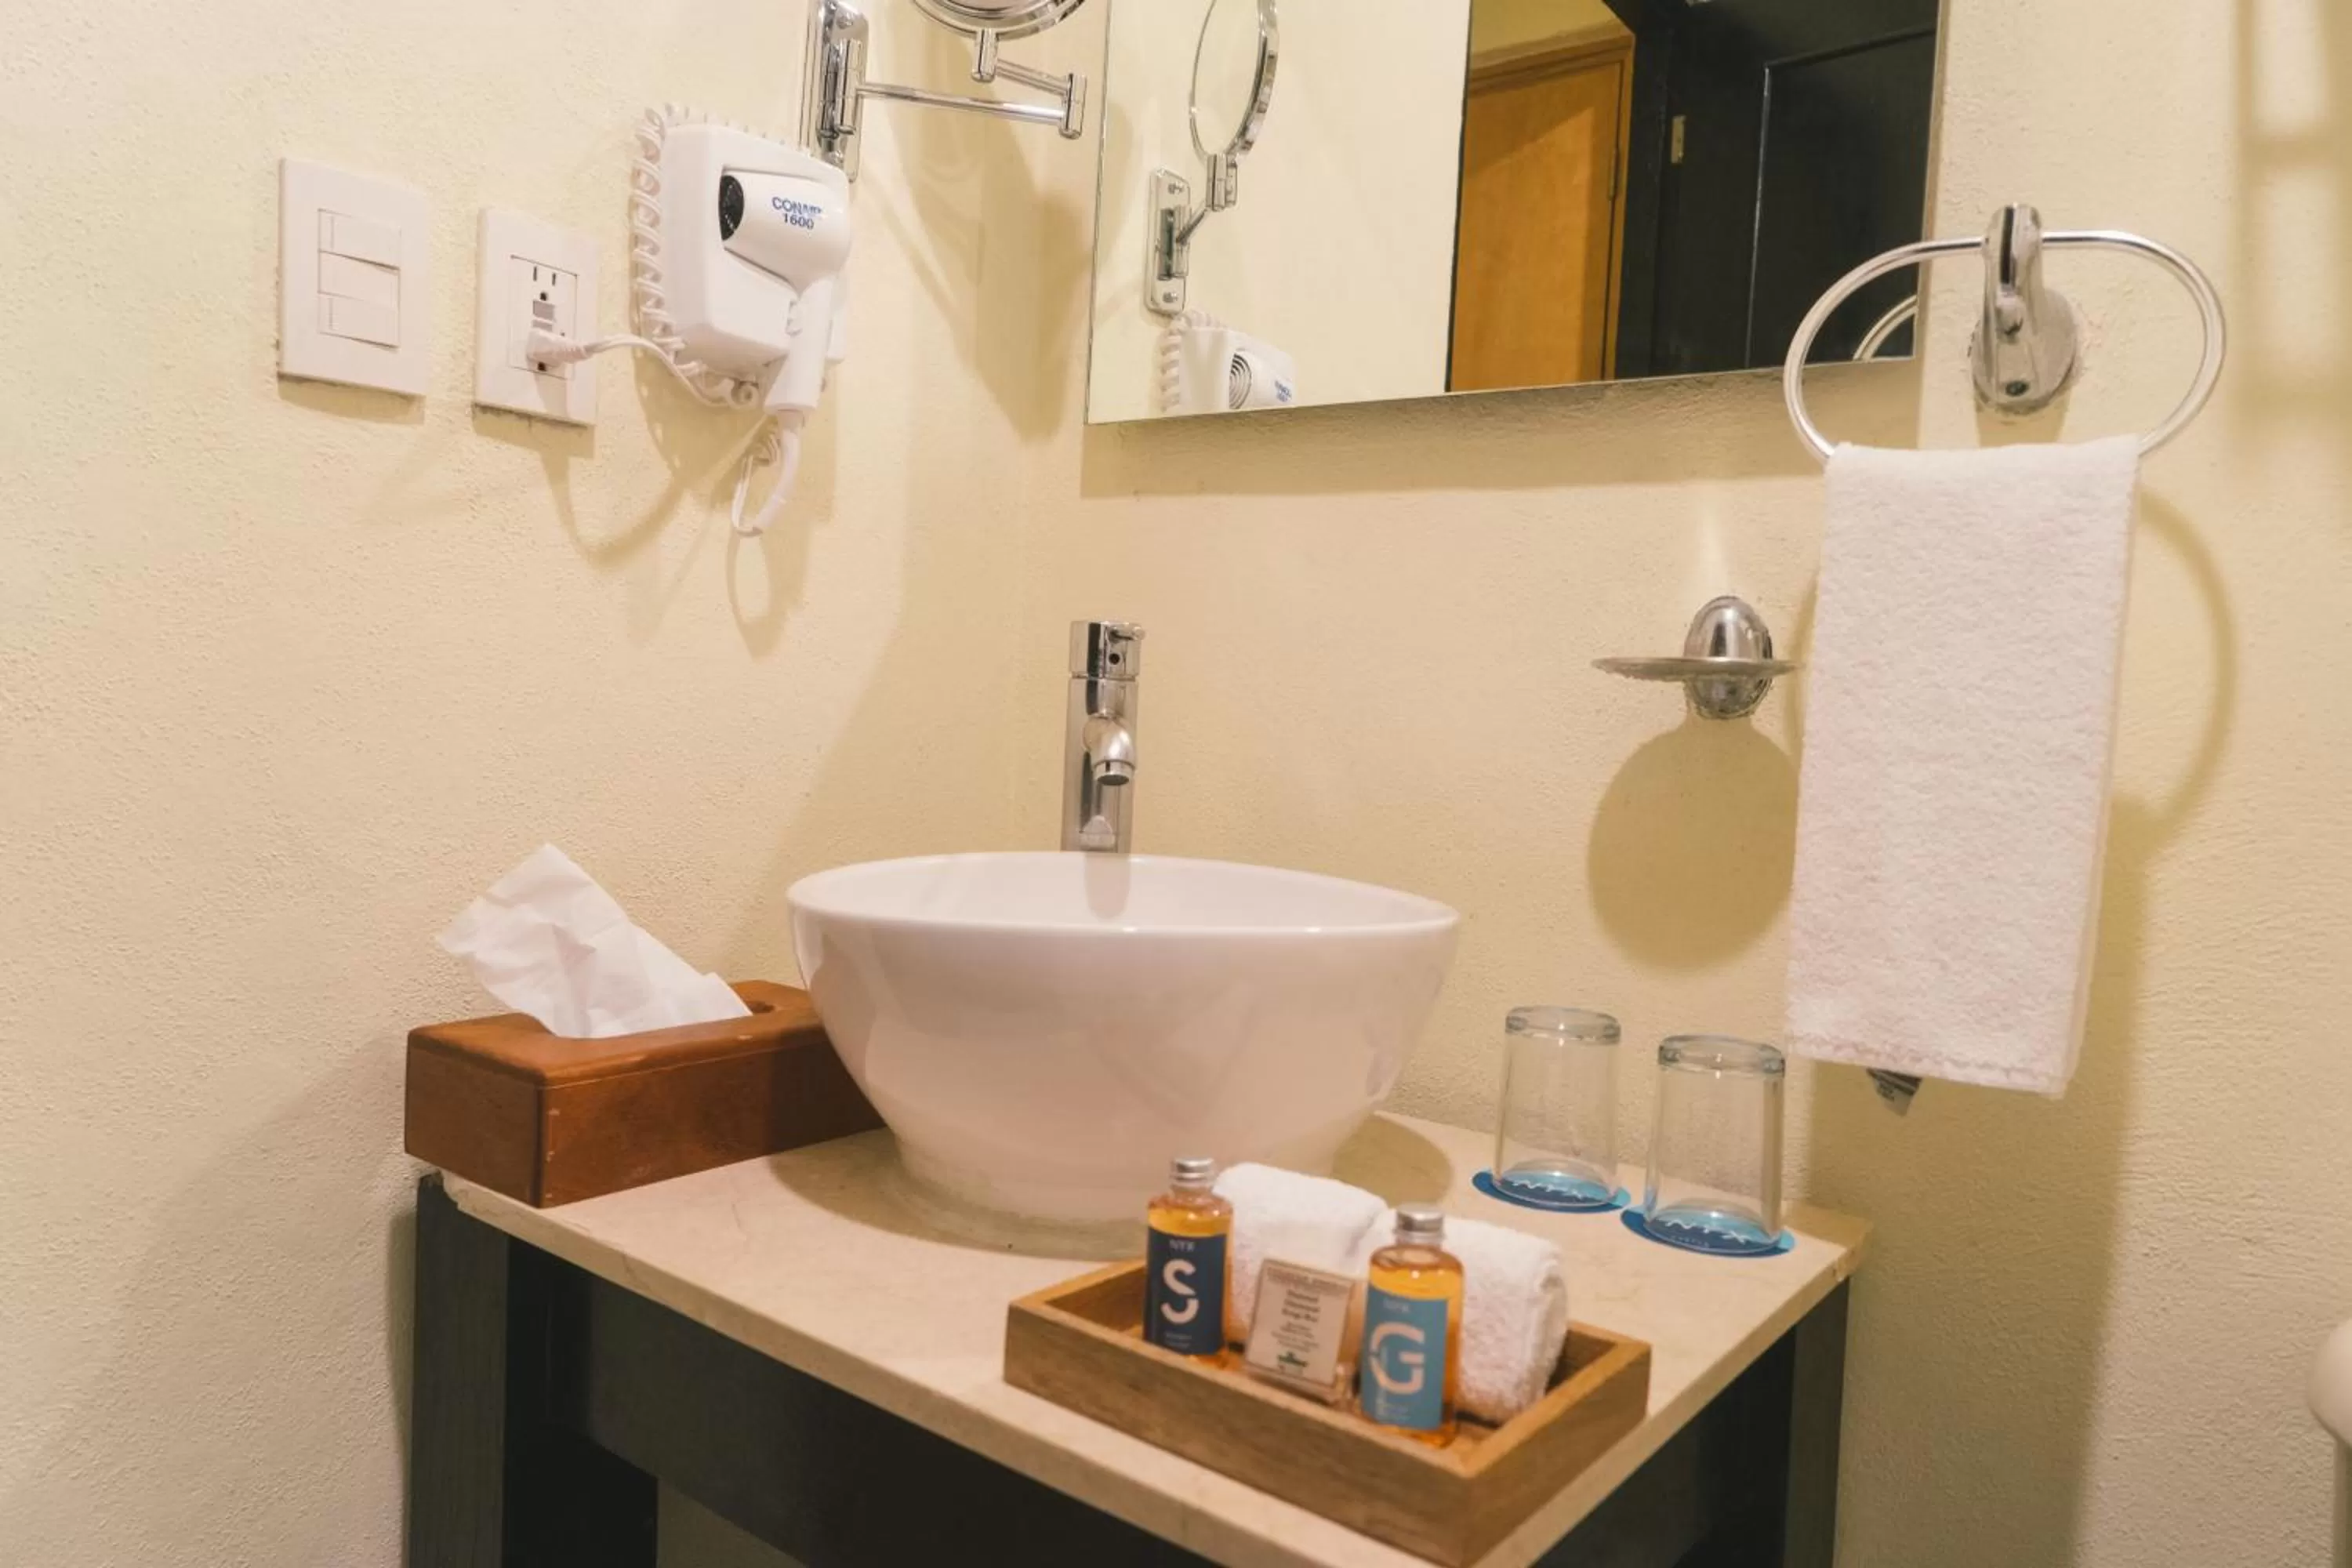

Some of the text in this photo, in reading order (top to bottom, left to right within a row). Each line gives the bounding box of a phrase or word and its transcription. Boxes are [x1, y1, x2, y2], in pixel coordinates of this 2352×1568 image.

[783, 212, 815, 230] 1600
[1160, 1258, 1200, 1325] S
[1369, 1321, 1425, 1395] G
